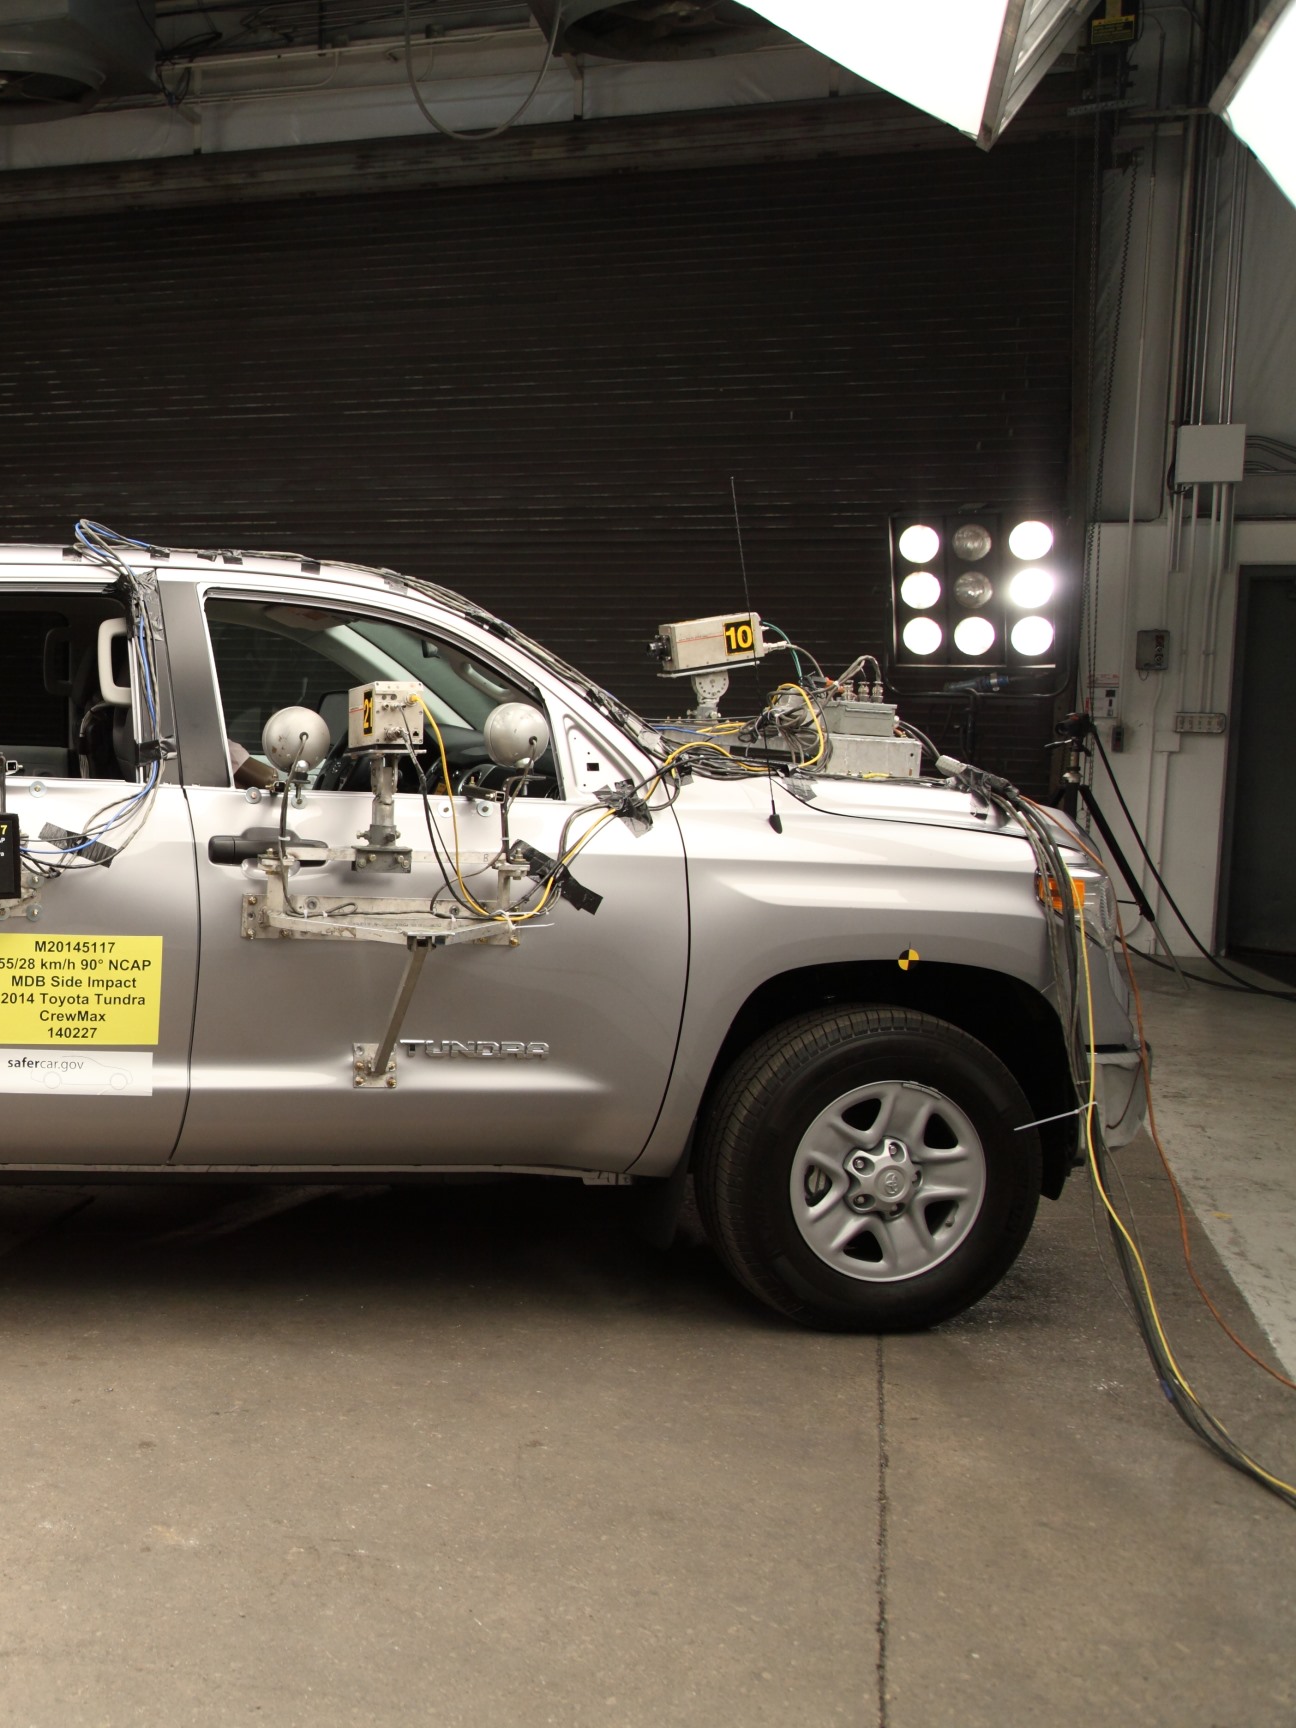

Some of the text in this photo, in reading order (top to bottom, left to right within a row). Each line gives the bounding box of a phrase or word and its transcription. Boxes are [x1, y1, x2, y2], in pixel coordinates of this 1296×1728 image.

[725, 625, 753, 650] 10
[34, 941, 115, 953] M20145117
[40, 959, 75, 970] km/h
[109, 960, 152, 971] NCAP
[11, 976, 136, 990] MDB Side Impact
[1, 993, 146, 1007] 2014 Toyota Tundra
[40, 1011, 106, 1021] CrewMax
[48, 1028, 97, 1038] 140227
[400, 1039, 550, 1059] TUNDRA
[7, 1057, 84, 1071] safercar.gov
